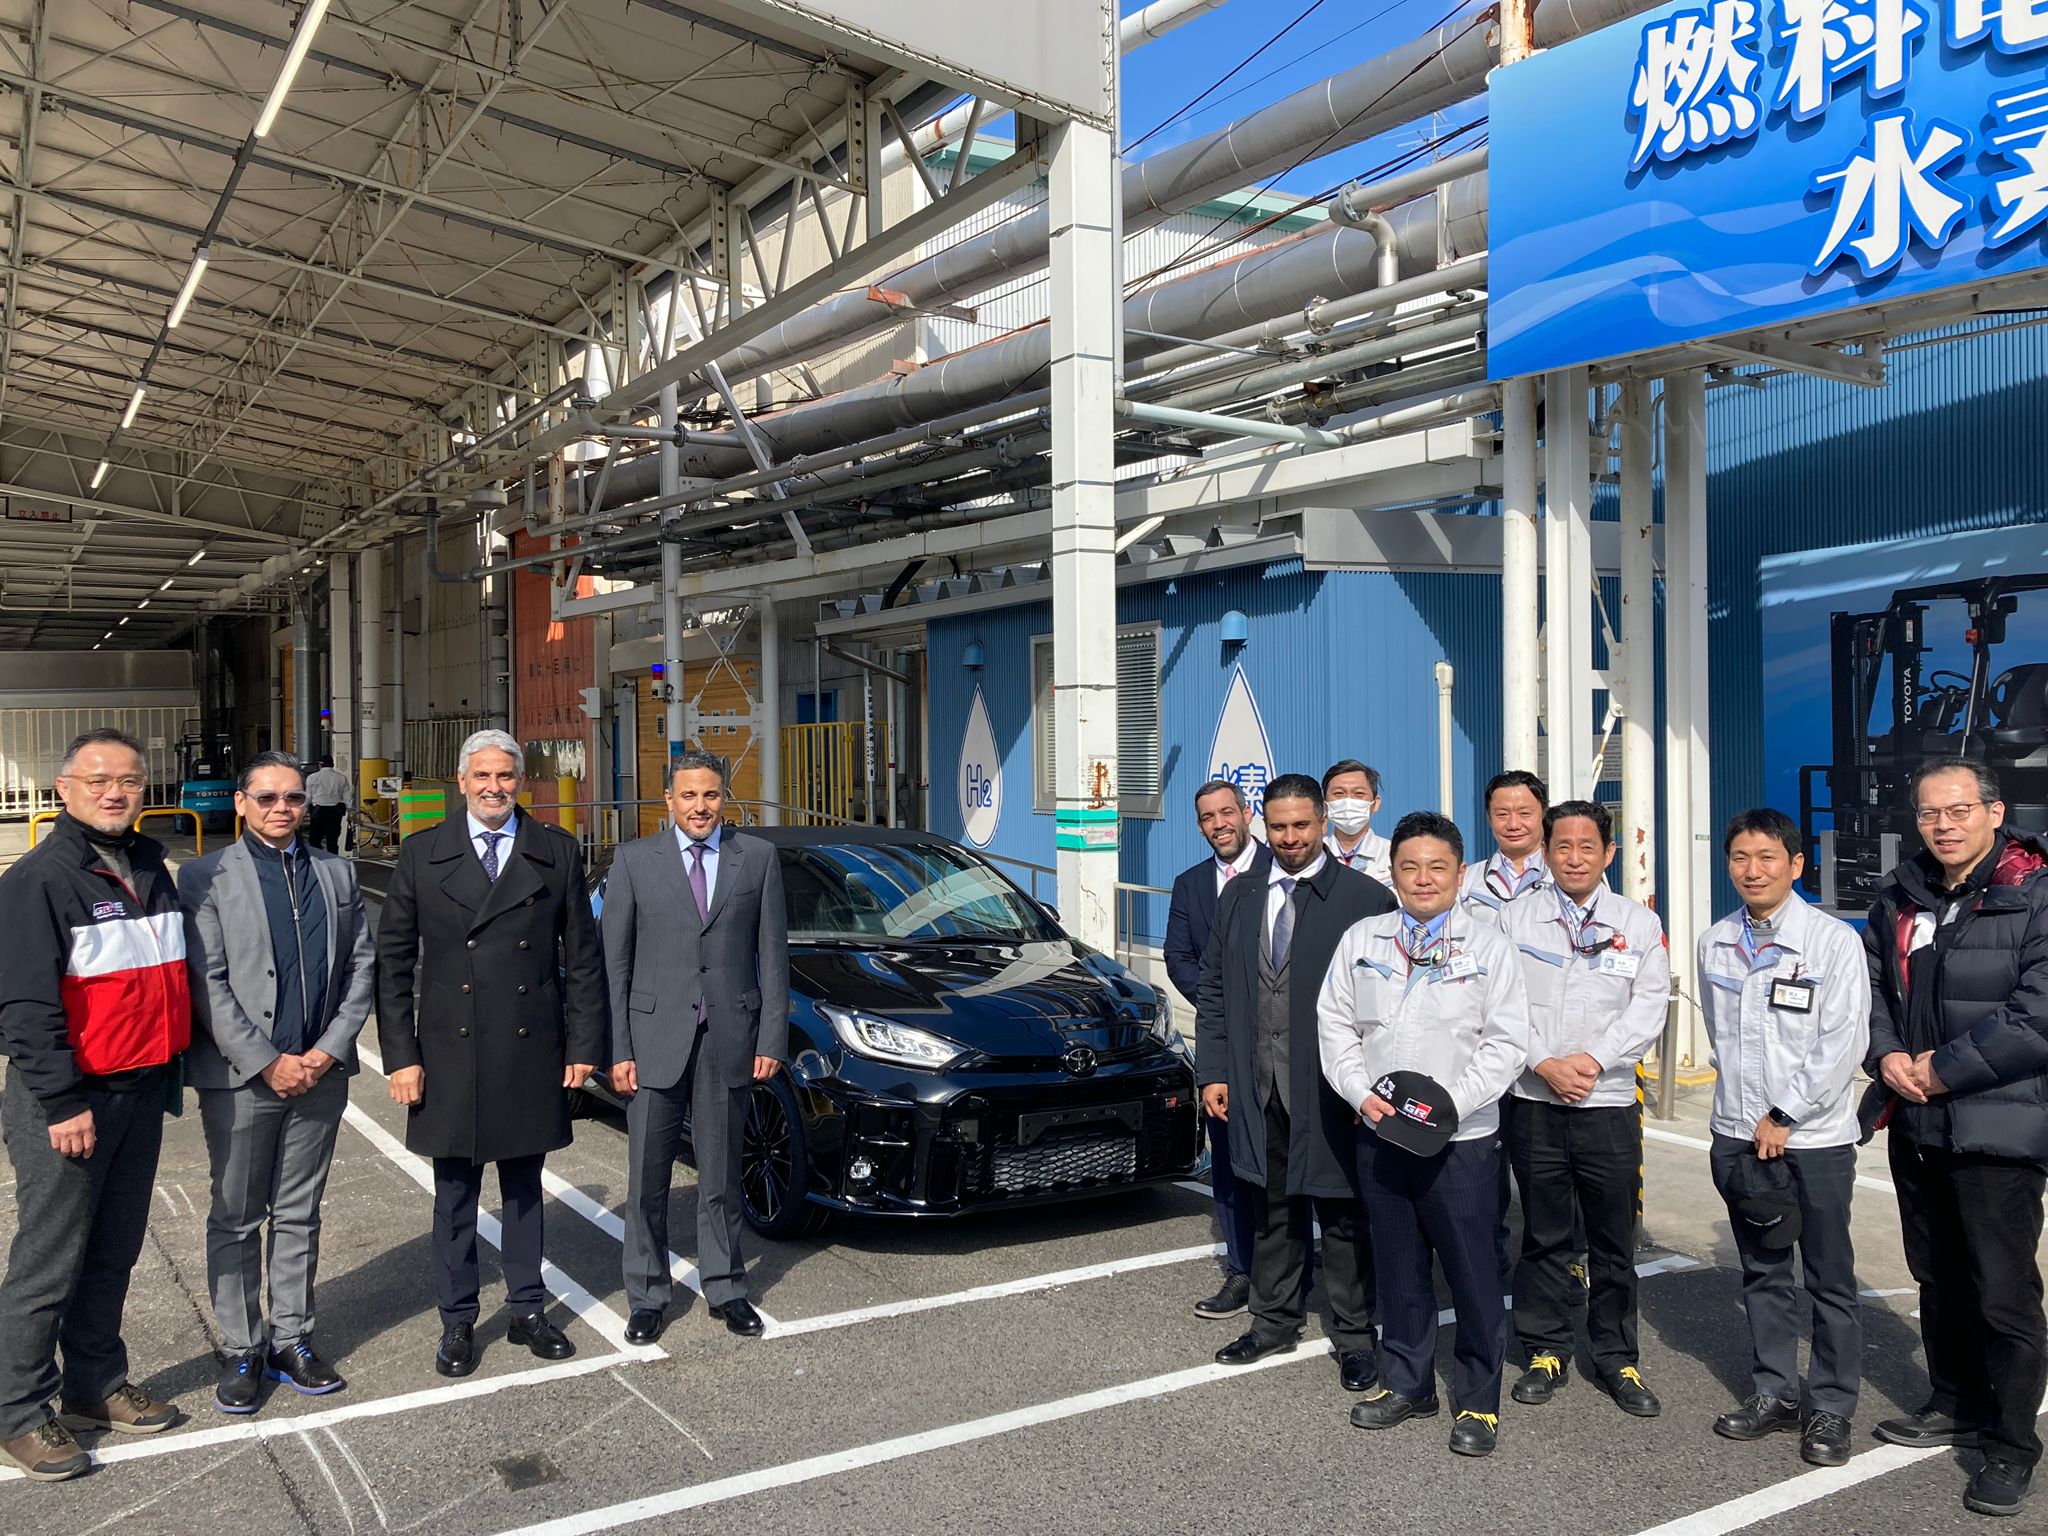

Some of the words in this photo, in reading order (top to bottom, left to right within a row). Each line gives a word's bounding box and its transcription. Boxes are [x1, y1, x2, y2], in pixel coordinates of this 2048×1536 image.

[1903, 667, 1912, 724] TOYOTA
[195, 790, 229, 798] TOYOTA
[1403, 1103, 1428, 1119] GR
